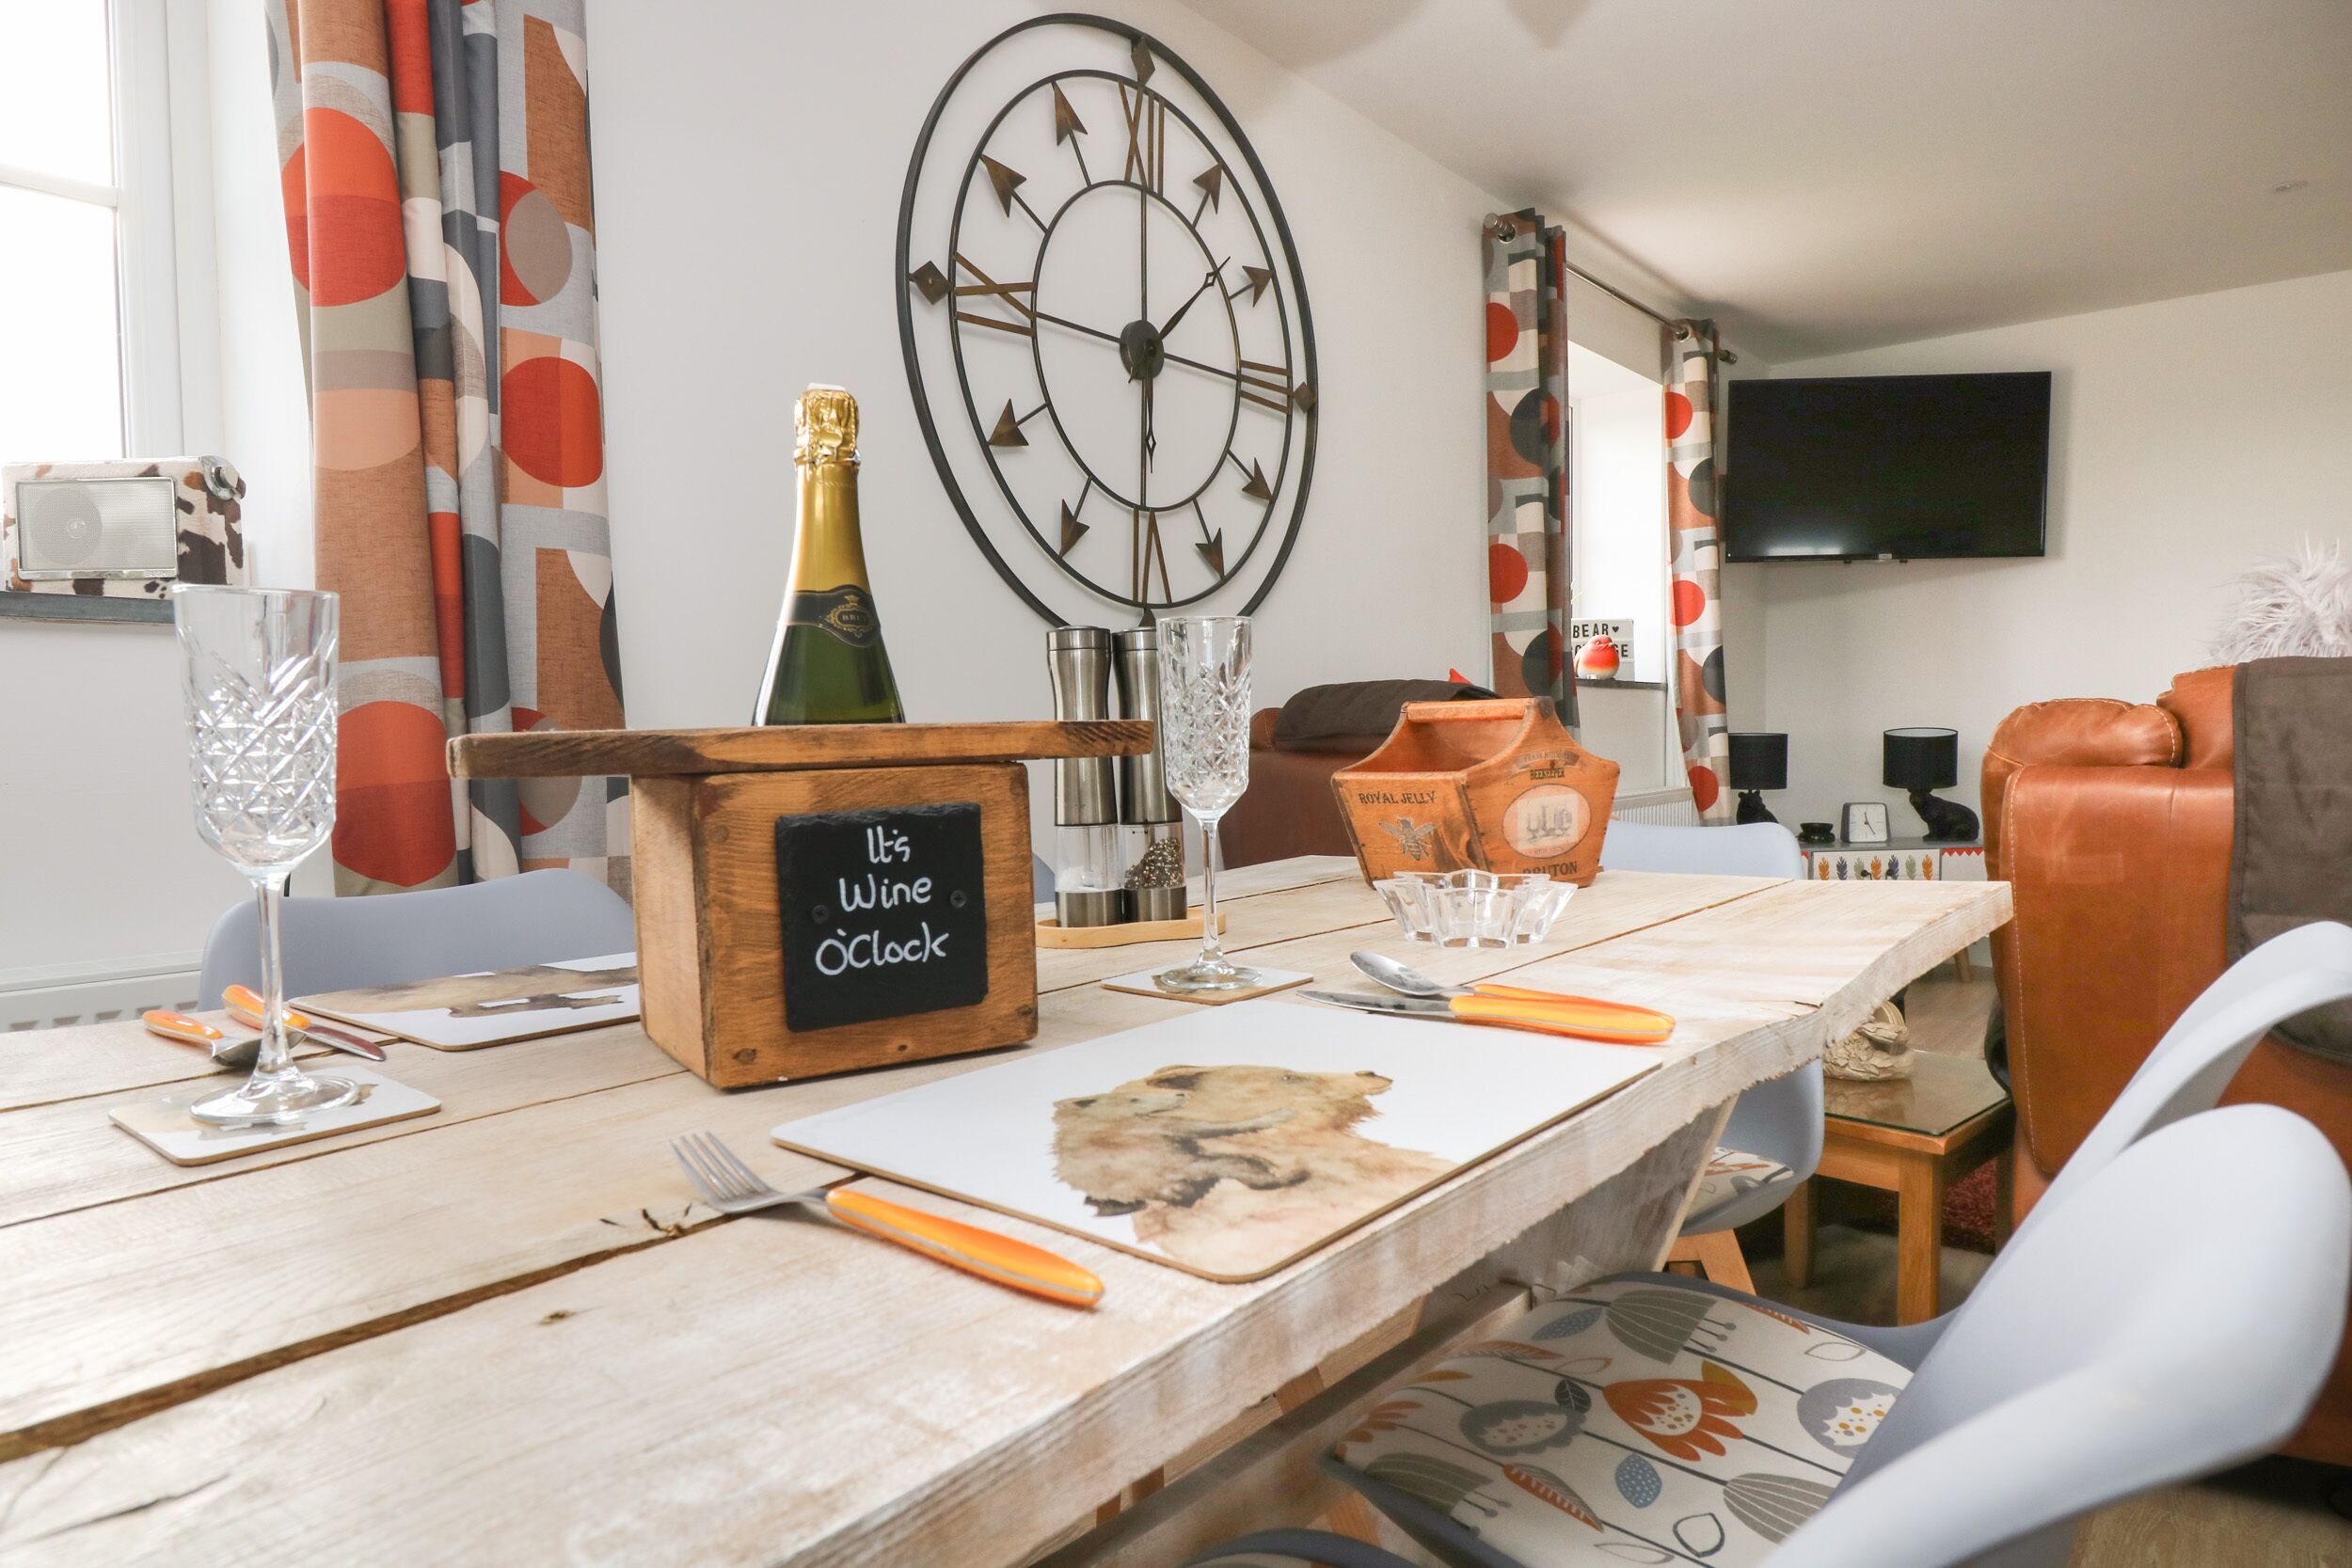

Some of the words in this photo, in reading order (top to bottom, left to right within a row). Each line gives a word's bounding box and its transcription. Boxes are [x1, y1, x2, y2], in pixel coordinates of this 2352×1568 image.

[1118, 80, 1166, 198] XII
[1238, 358, 1292, 416] III
[1572, 623, 1609, 639] BEAR
[1530, 767, 1565, 781] BEEKEEPER
[1359, 792, 1399, 804] ROYAL
[1401, 791, 1435, 804] JELLY
[838, 873, 932, 911] Wine
